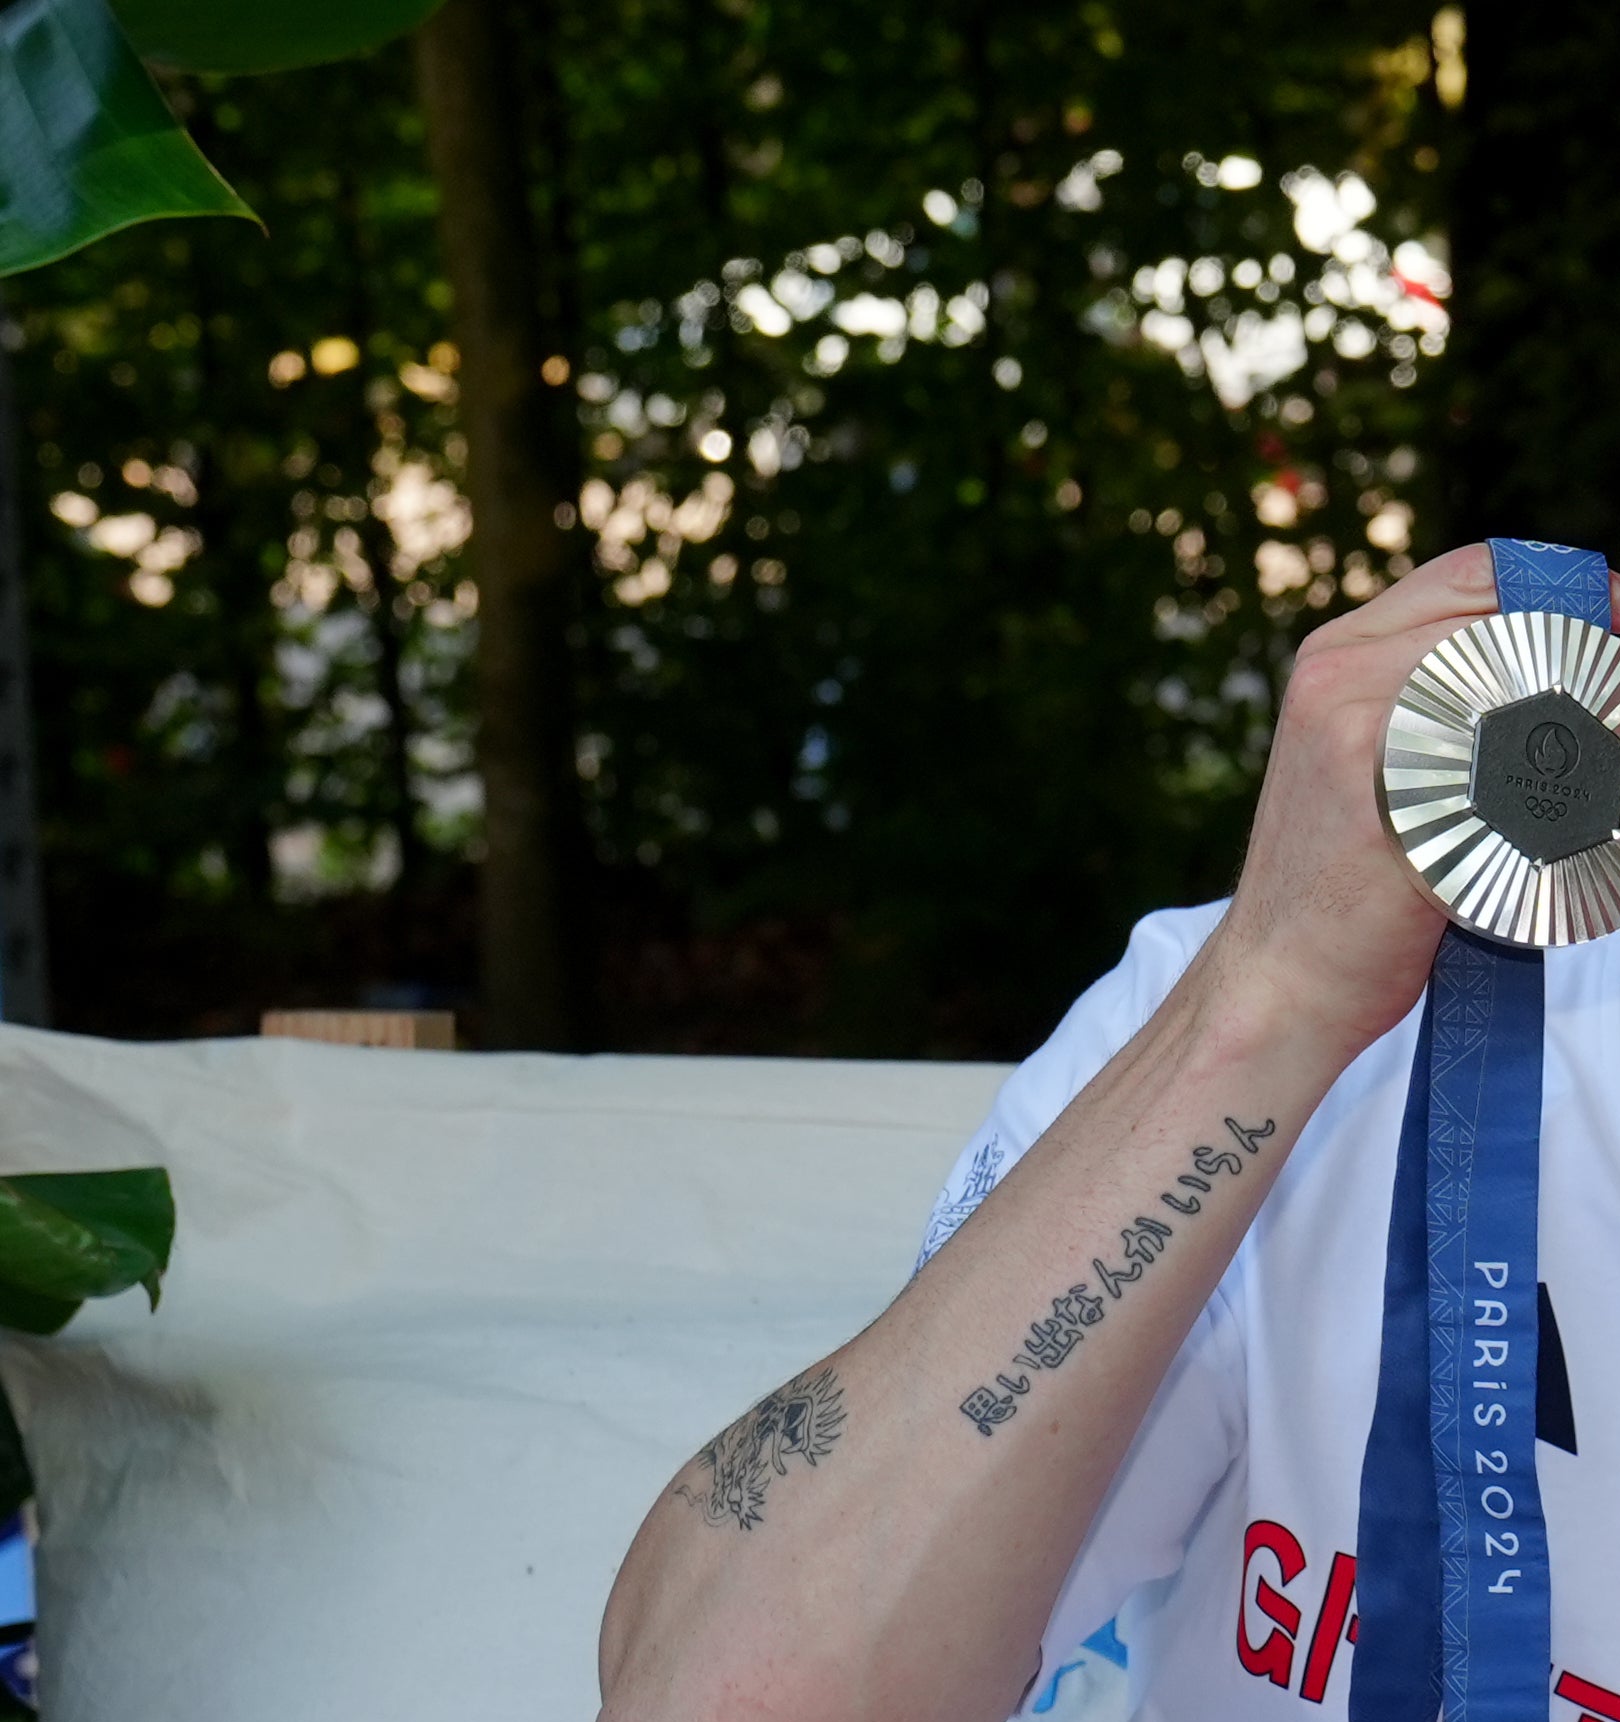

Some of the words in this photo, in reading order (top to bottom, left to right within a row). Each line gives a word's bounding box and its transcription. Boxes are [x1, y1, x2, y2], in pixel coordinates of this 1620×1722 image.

[1505, 775, 1548, 793] PARIS
[1552, 784, 1592, 801] 2024
[1474, 1449, 1522, 1595] 2024
